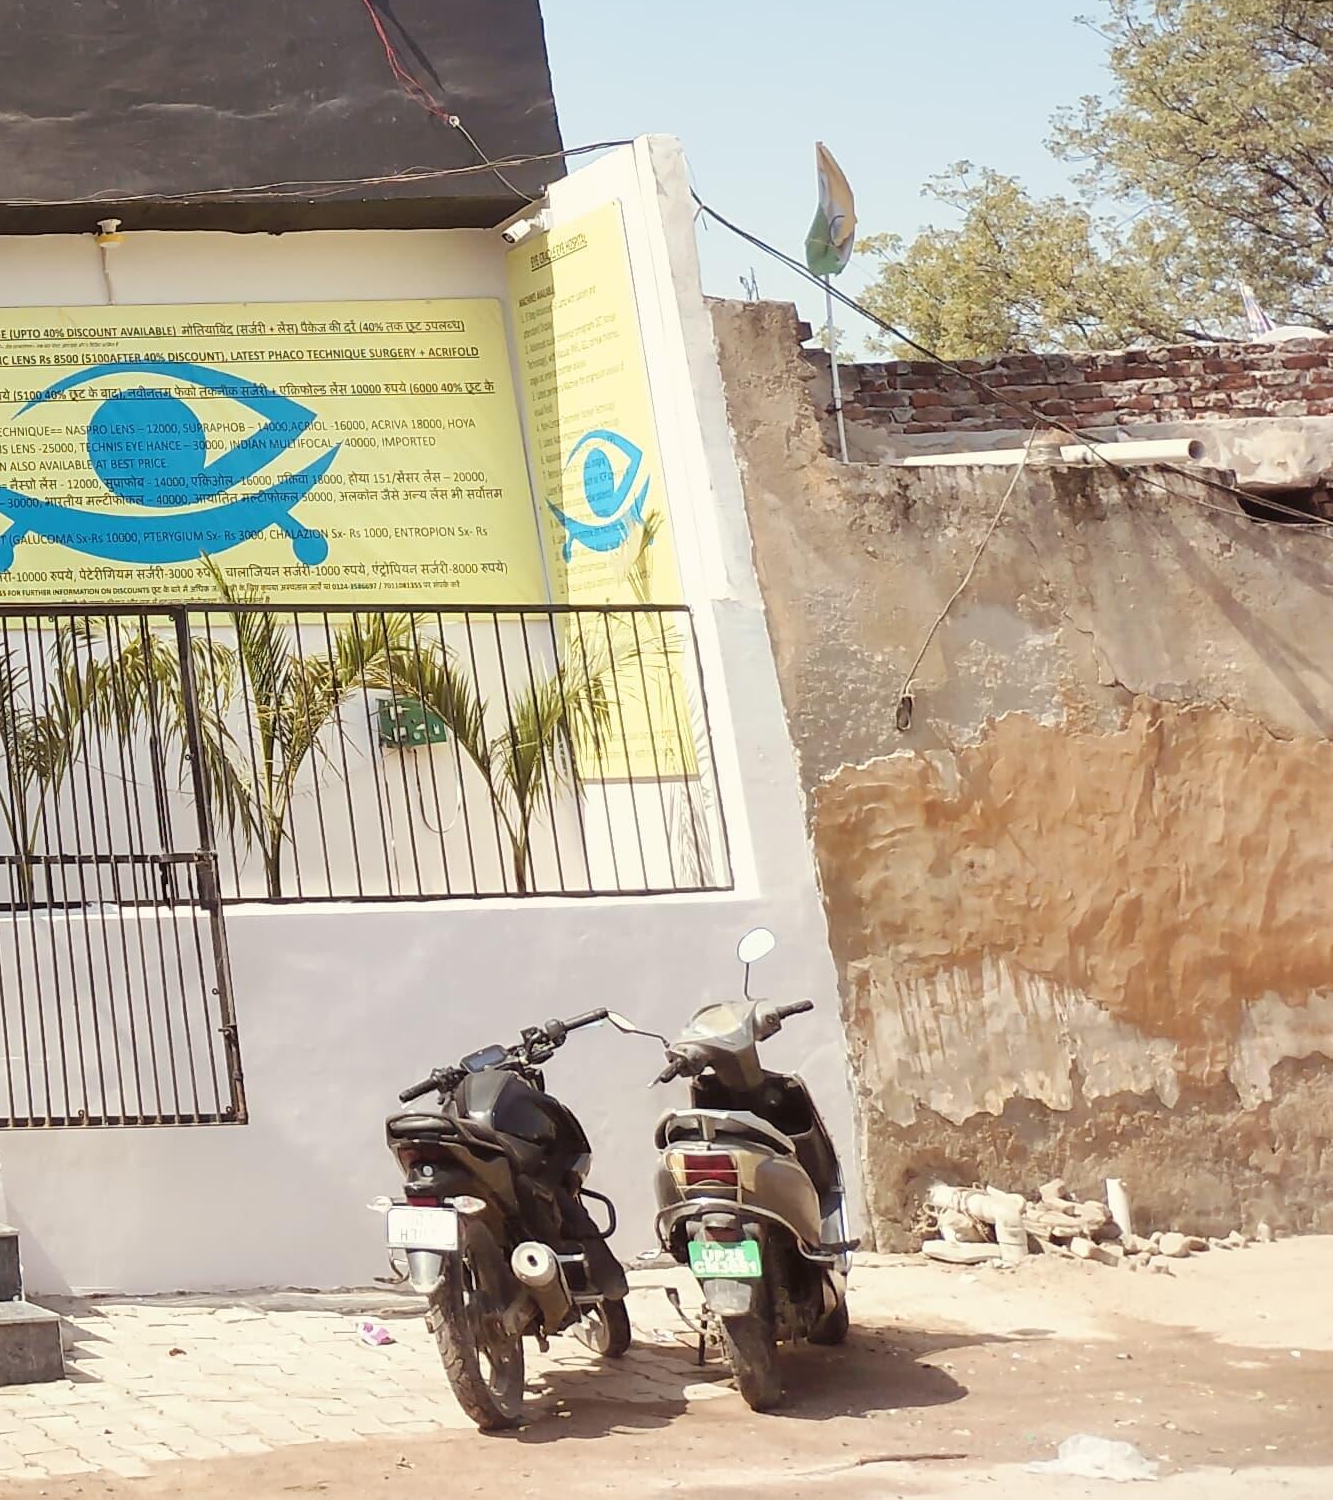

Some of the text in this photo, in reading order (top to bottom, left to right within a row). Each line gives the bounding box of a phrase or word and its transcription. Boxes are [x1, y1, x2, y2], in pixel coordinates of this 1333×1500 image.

[43, 329, 64, 337] 40%
[67, 327, 117, 337] DISCOUNT
[11, 355, 36, 365] LENS
[39, 354, 50, 364] Rs
[53, 354, 78, 363] 8500
[144, 352, 165, 362] 40%
[232, 350, 264, 360] LATEST
[269, 350, 304, 360] PHACO
[306, 349, 367, 360] TECHNIQUE
[370, 348, 416, 358] SURGERY
[428, 347, 478, 357] ACRIFOLD
[351, 384, 381, 394] 10000
[441, 382, 462, 393] 40%
[65, 425, 107, 435] NASPRO
[110, 425, 135, 435] LENS
[371, 420, 408, 430] ACRIVA
[447, 418, 476, 428] HOYA
[80, 441, 123, 452] TECHNIS
[230, 439, 266, 450] INDIAN
[269, 436, 333, 449] MULTIFOCAL
[382, 436, 435, 446] IMPORTED
[39, 459, 93, 470] AVAILABLE
[96, 459, 108, 469] AT
[111, 458, 134, 469] BEST
[269, 527, 328, 539] CHALAZION
[395, 526, 454, 538] ENTROPION
